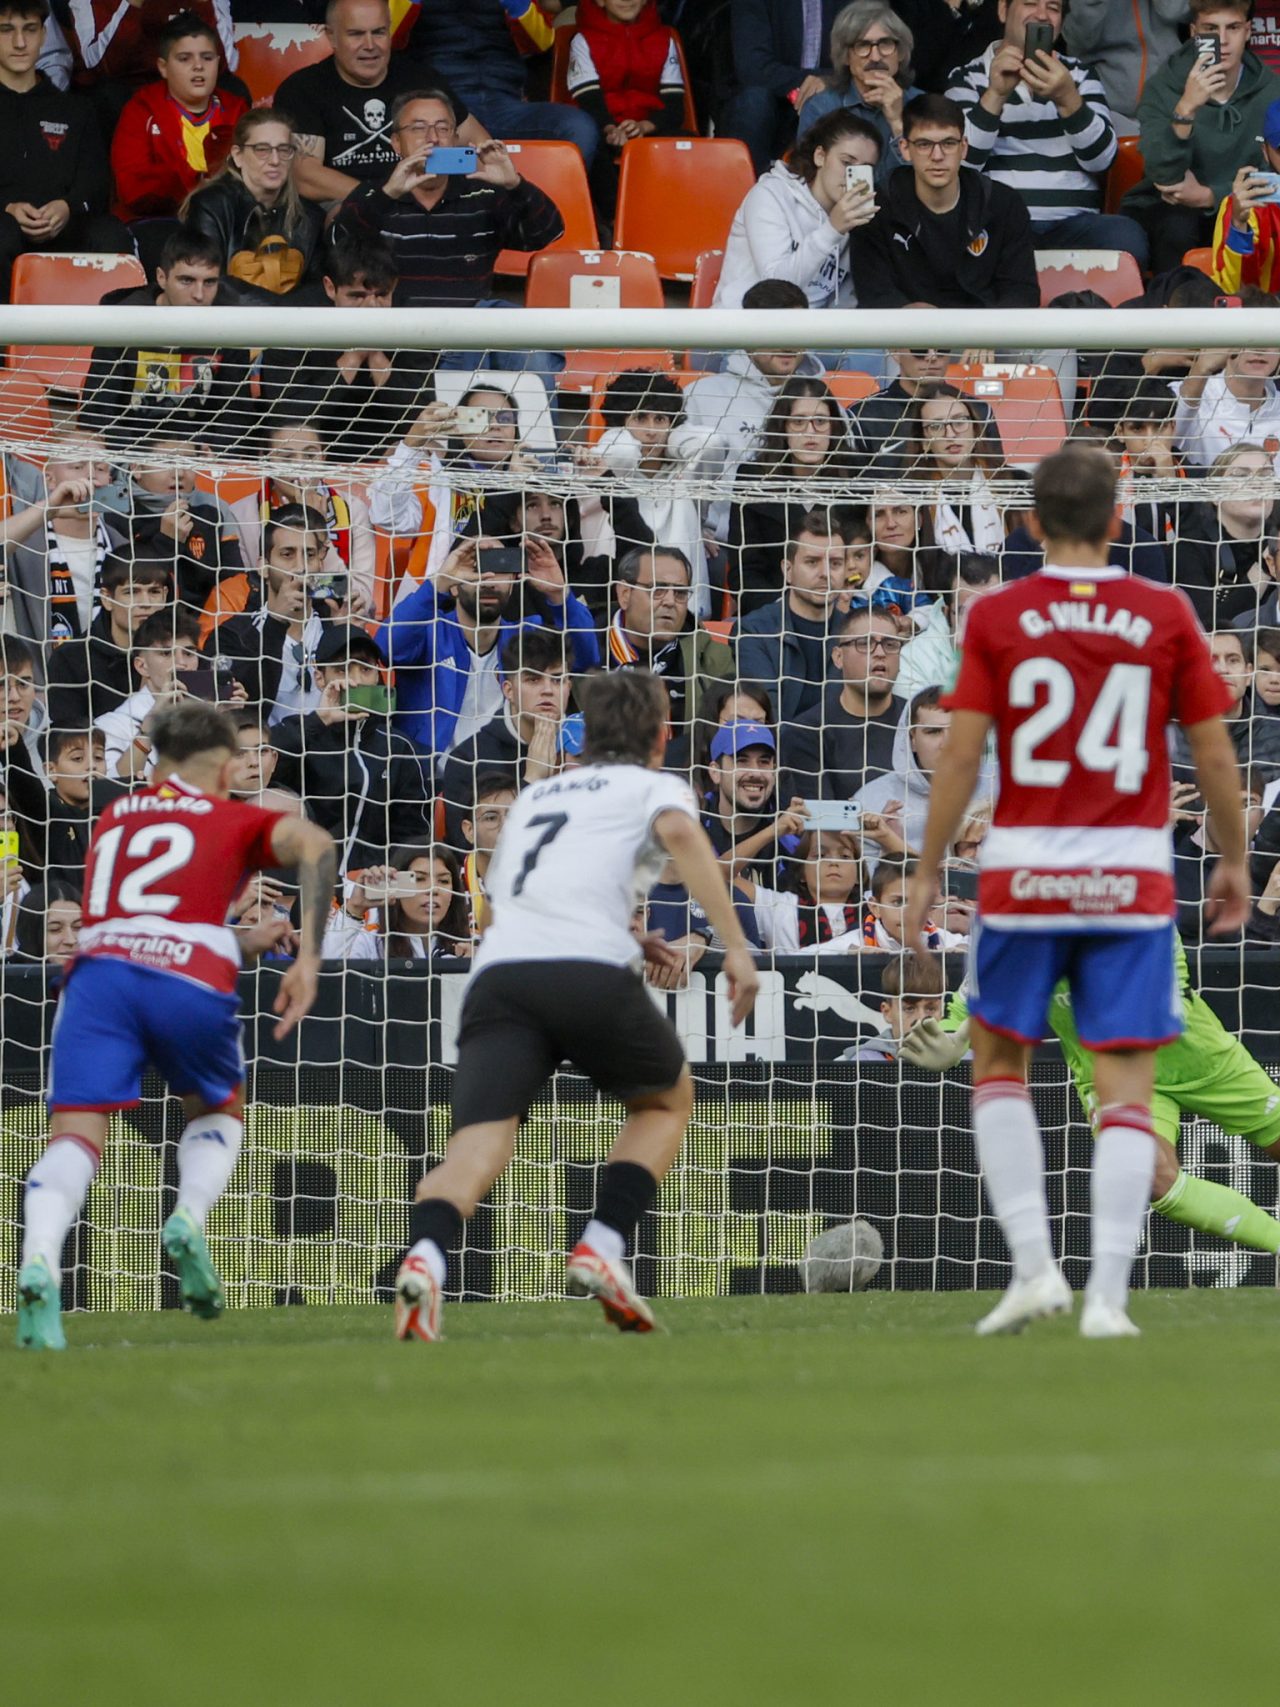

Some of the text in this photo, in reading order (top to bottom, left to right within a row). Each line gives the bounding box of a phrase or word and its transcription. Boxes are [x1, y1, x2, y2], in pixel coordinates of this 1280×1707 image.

[1009, 656, 1153, 793] 24
[88, 822, 195, 917] 12
[512, 811, 569, 897] 7
[1010, 868, 1138, 907] Greening
